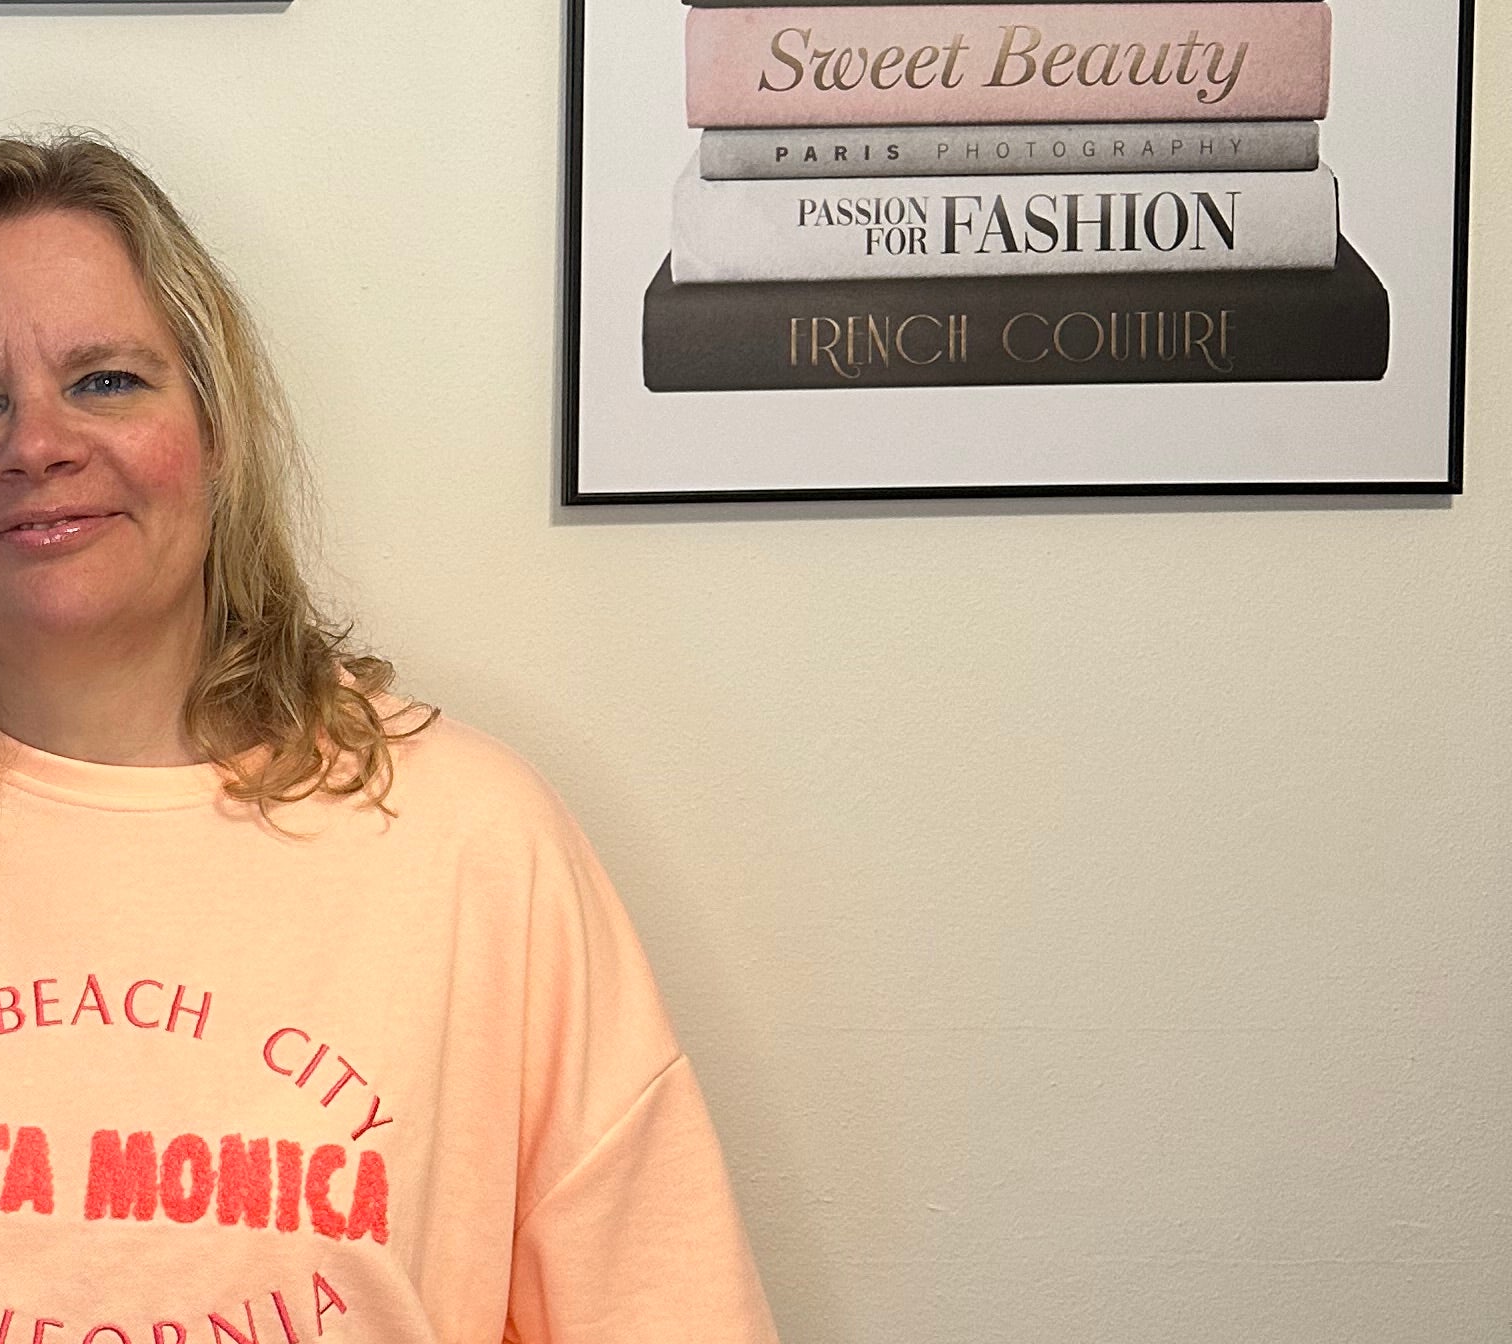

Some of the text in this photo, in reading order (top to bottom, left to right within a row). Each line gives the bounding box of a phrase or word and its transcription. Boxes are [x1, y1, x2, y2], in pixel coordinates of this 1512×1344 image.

[757, 23, 1250, 105] Sweet Beauty
[775, 138, 1243, 163] PARIS PHOTOGRAPHY
[796, 195, 930, 228] PASSION
[864, 190, 1243, 256] FOR FASHION
[790, 308, 1238, 380] FRENCH COUTURE
[262, 1026, 394, 1142] CITY
[84, 1128, 390, 1246] MONICA
